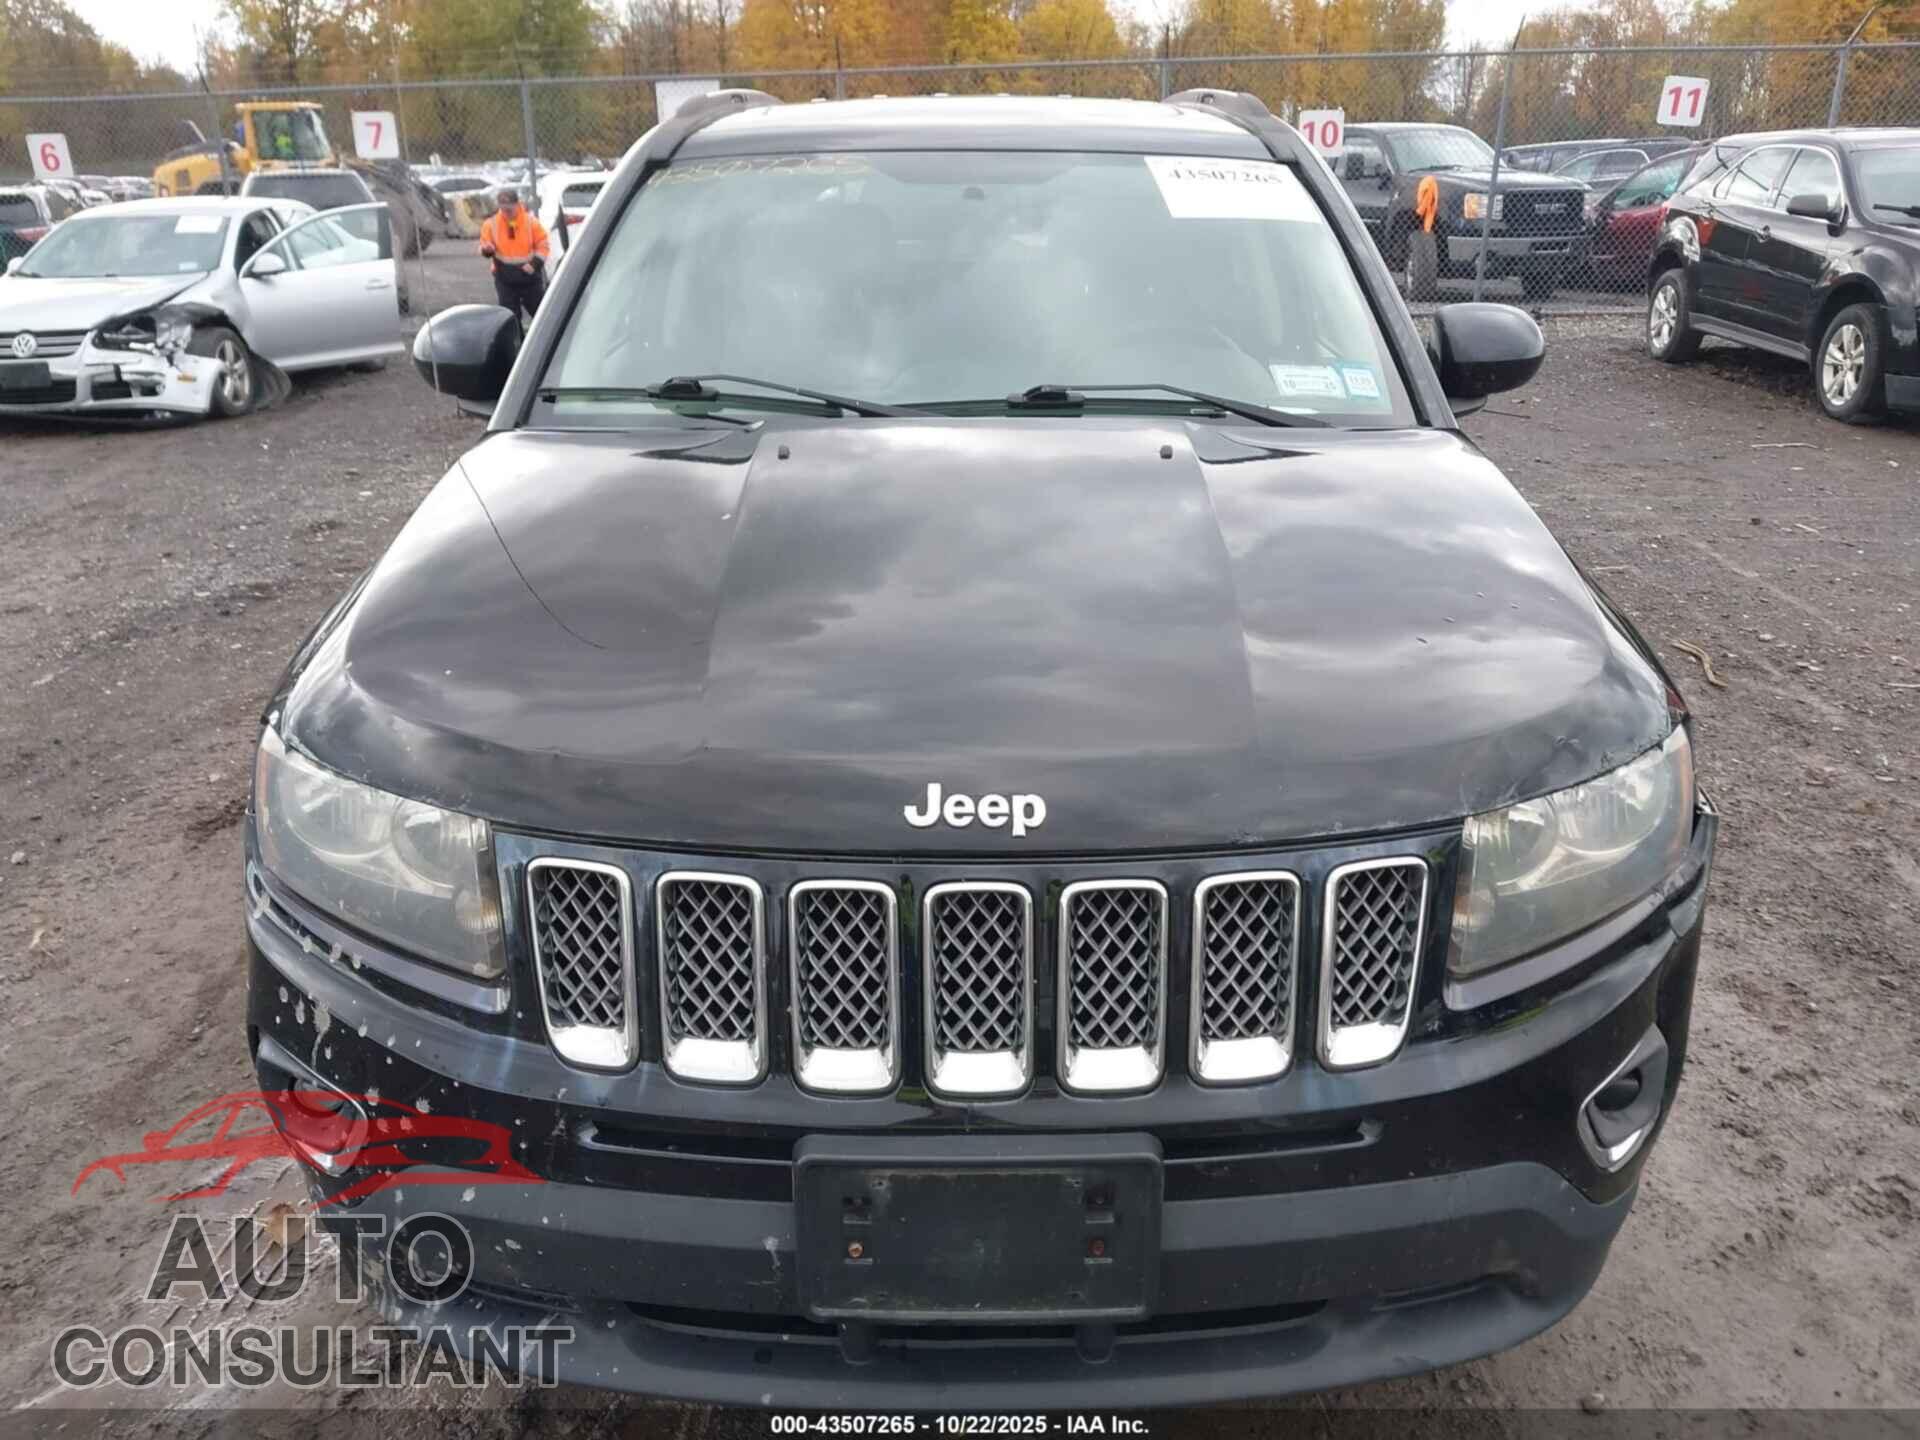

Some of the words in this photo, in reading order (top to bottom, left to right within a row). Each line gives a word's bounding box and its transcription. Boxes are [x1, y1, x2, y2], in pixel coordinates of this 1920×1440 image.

[1668, 86, 1702, 118] 11
[364, 121, 382, 150] 7
[1303, 120, 1340, 148] 10
[40, 142, 61, 172] 6
[904, 782, 1047, 837] Jeep
